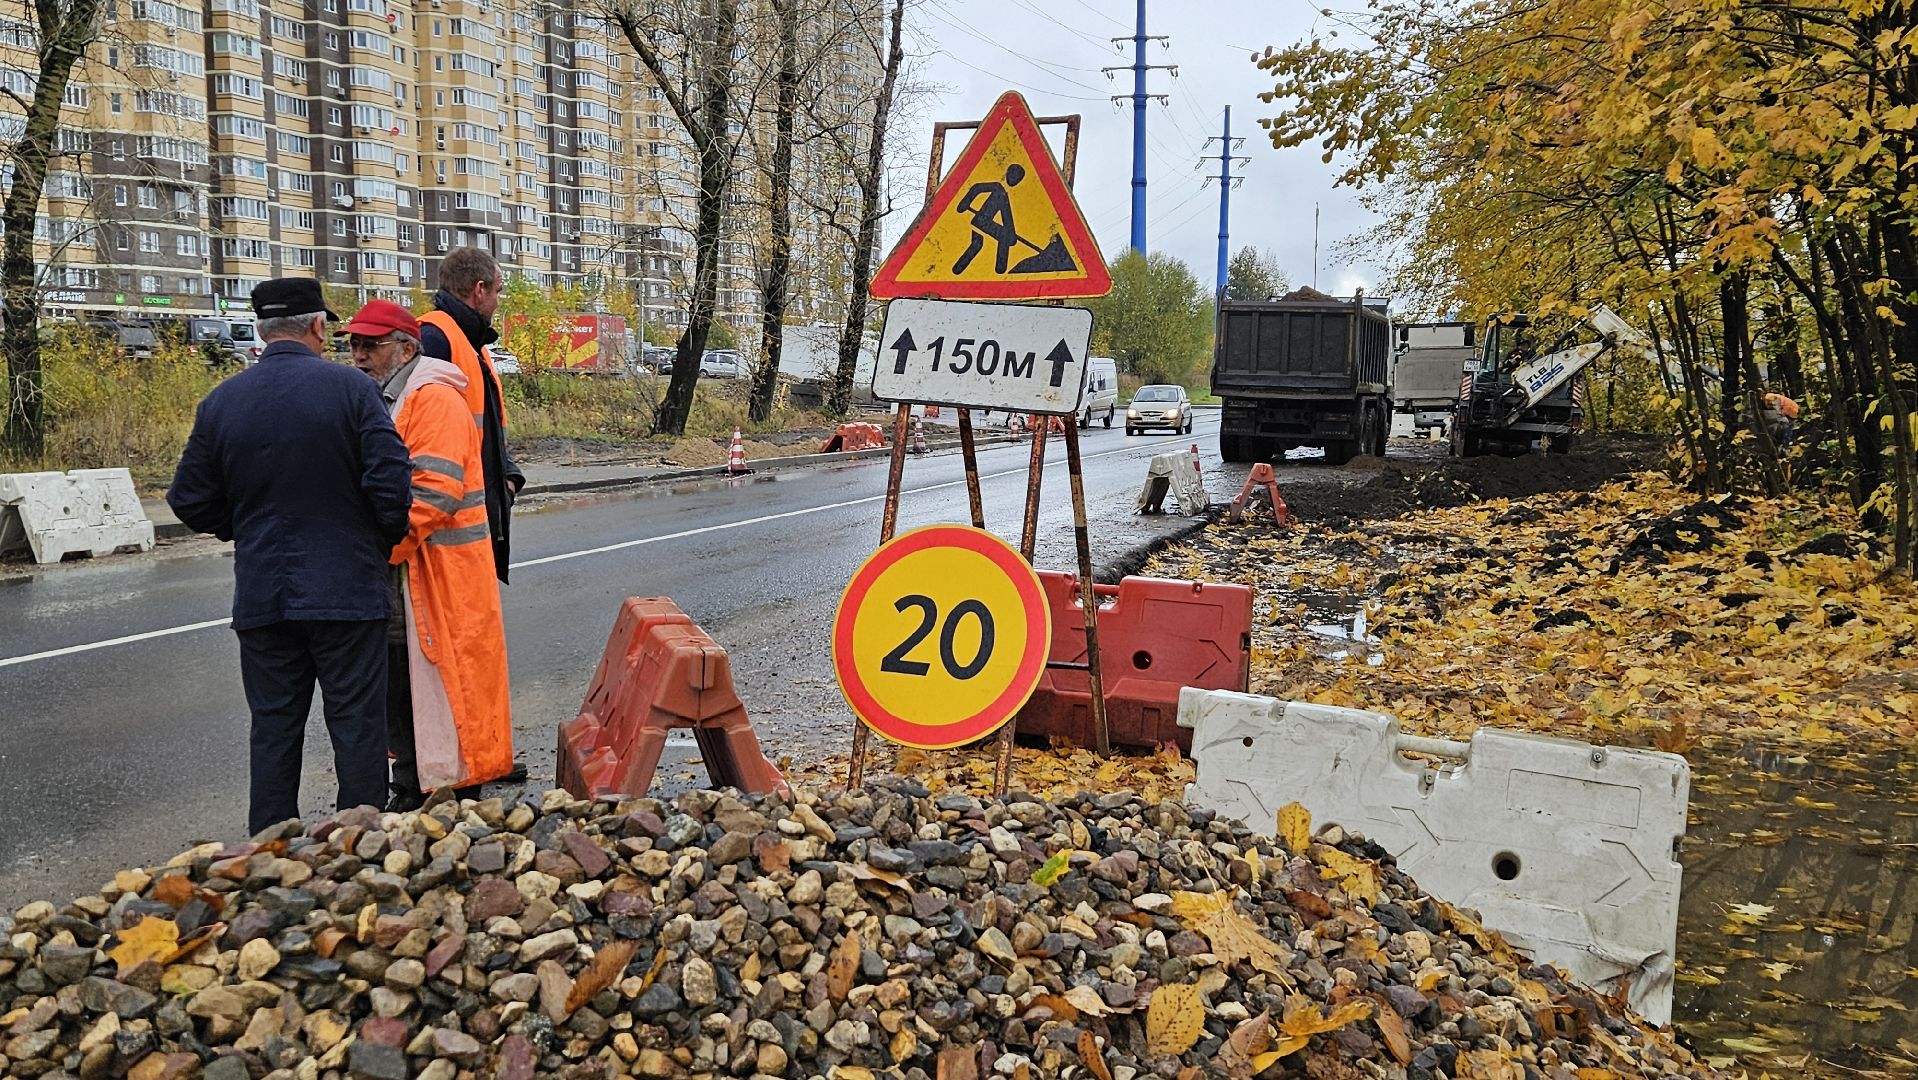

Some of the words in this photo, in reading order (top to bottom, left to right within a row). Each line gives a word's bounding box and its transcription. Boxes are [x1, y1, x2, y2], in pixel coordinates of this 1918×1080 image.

[1526, 366, 1548, 384] TLB
[1530, 362, 1565, 393] 825
[880, 594, 995, 681] 20
